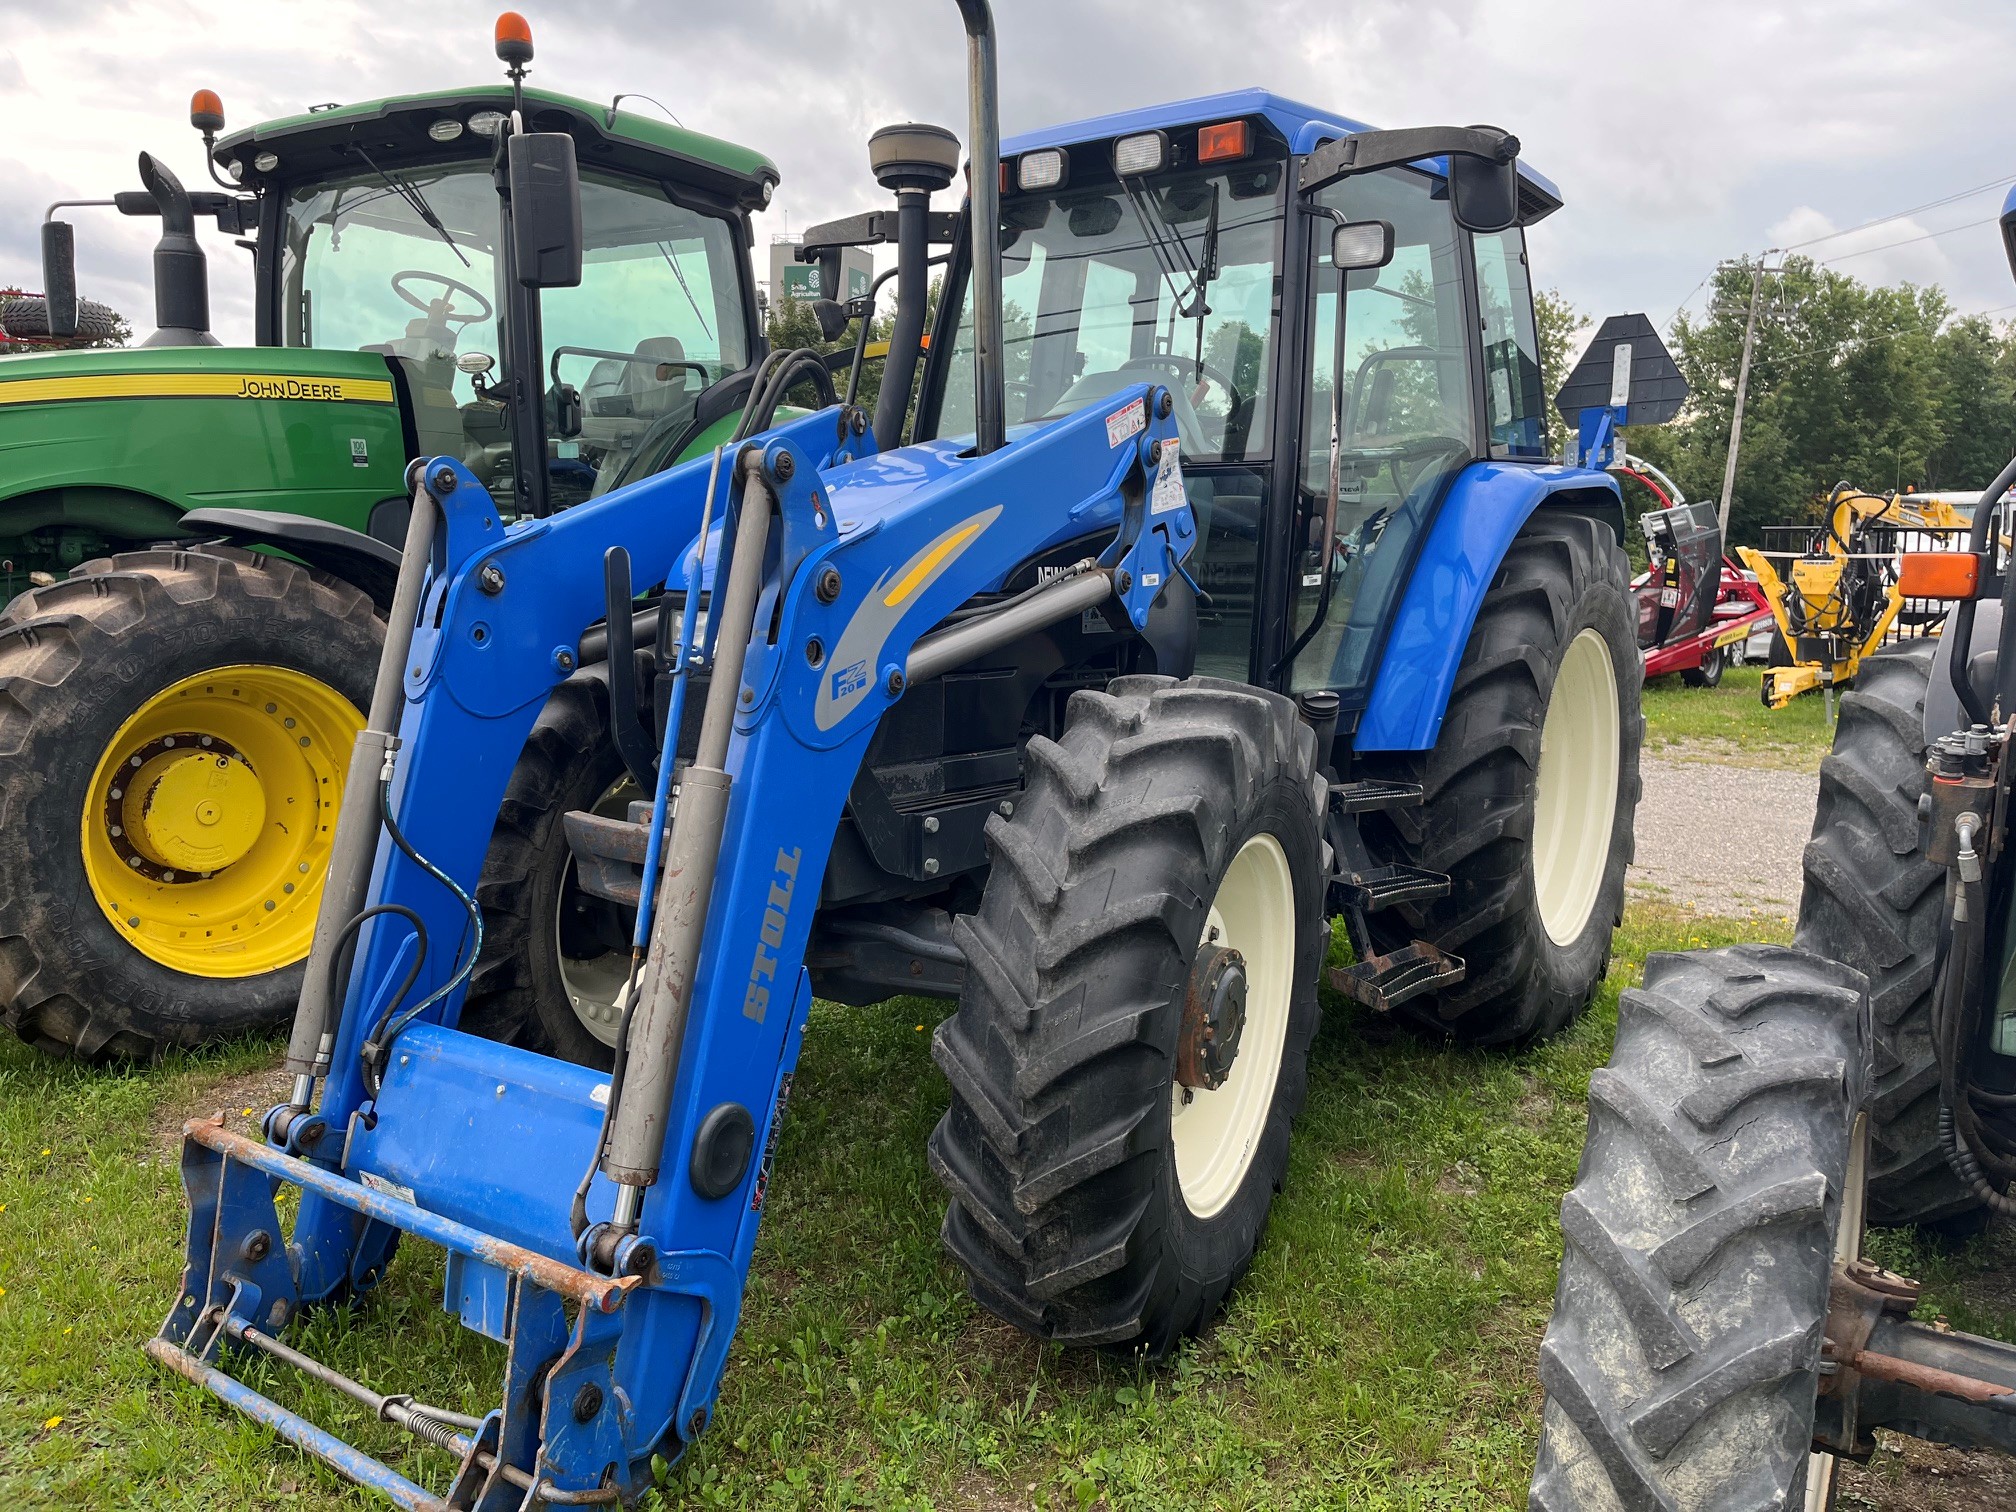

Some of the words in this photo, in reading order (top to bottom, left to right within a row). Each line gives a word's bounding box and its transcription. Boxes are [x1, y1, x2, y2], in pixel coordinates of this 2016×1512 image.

[238, 378, 285, 396] JOHN
[287, 380, 343, 398] DEERE
[353, 441, 365, 450] 100
[840, 683, 855, 697] 20
[742, 846, 802, 1025] STOLL
